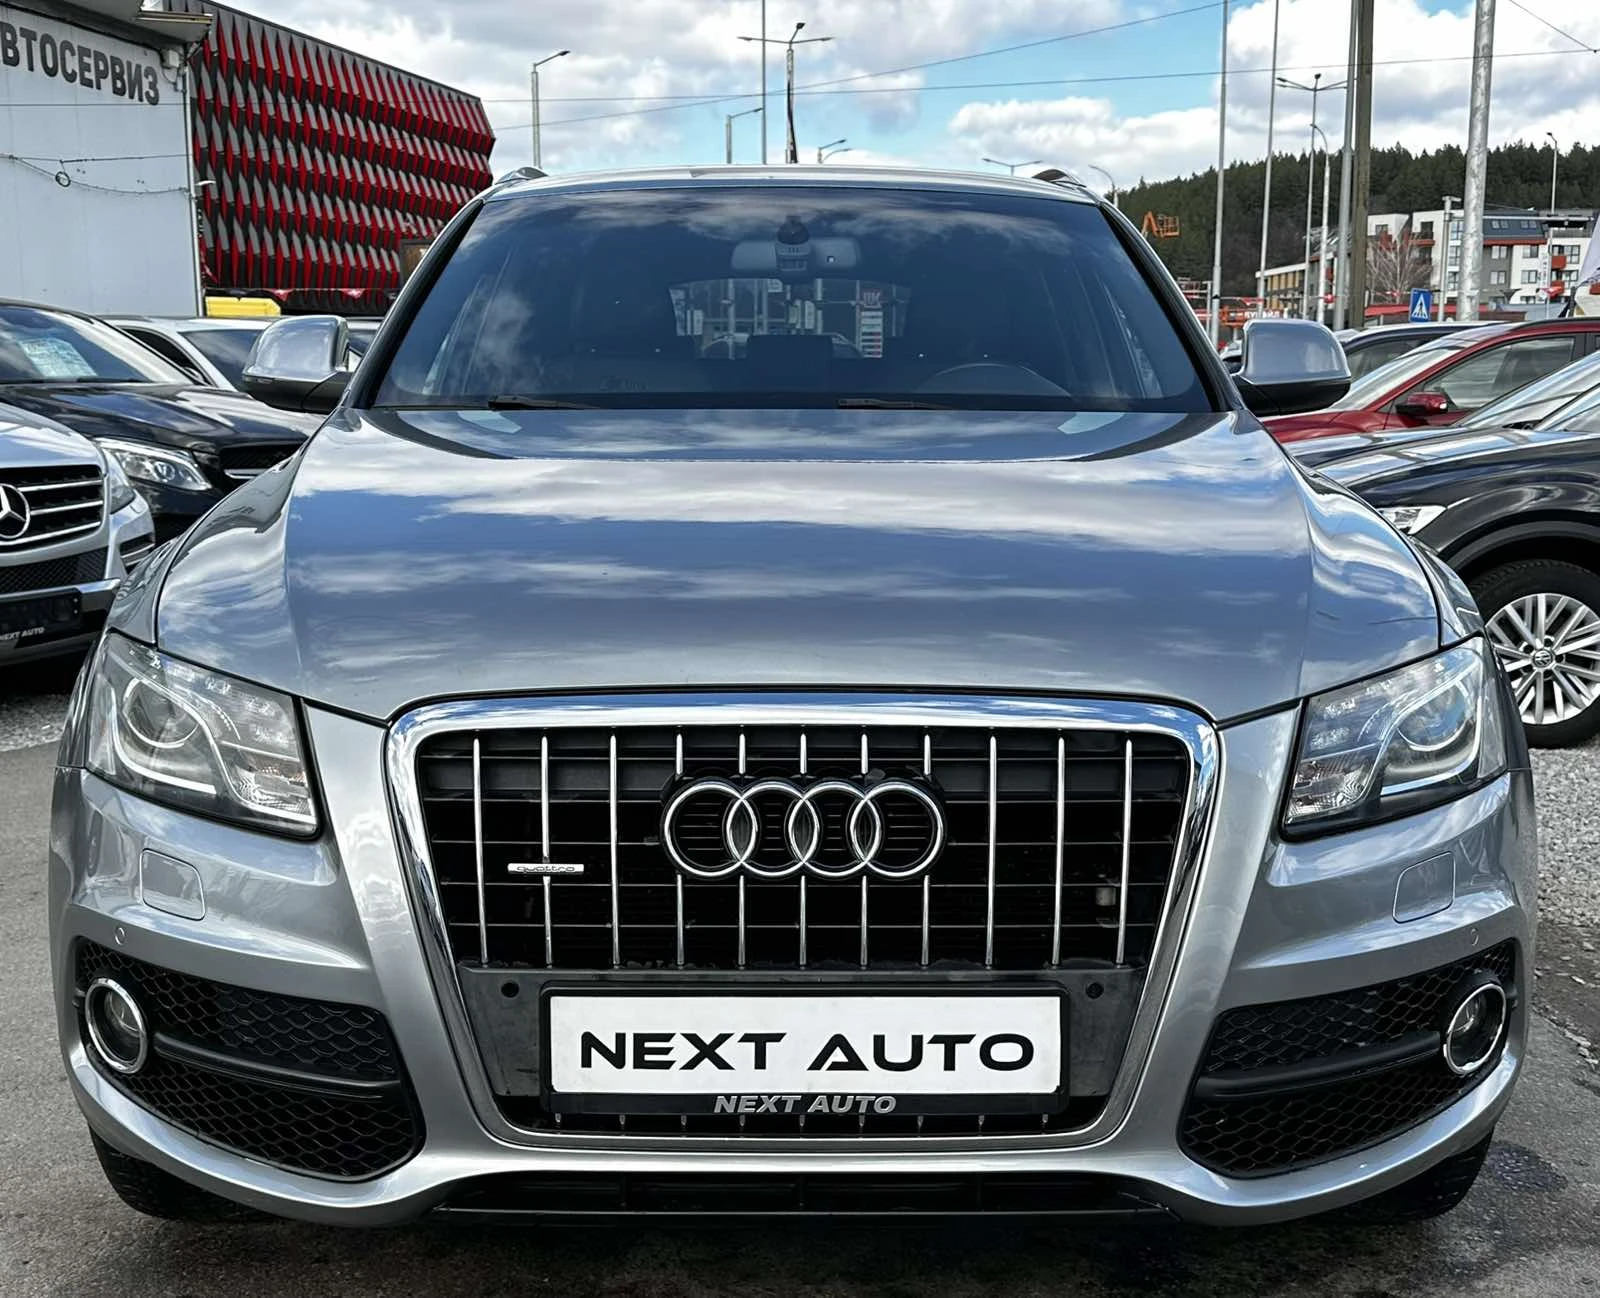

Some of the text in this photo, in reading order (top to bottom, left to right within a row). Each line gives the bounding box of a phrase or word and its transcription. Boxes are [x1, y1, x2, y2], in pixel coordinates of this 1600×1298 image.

[0, 21, 160, 106] ВТОСЕРВИЗ
[21, 626, 45, 638] AUTO
[516, 865, 576, 874] quattro
[580, 1031, 1035, 1072] NEXT AUTO
[713, 1095, 897, 1114] NEXT AUTO
